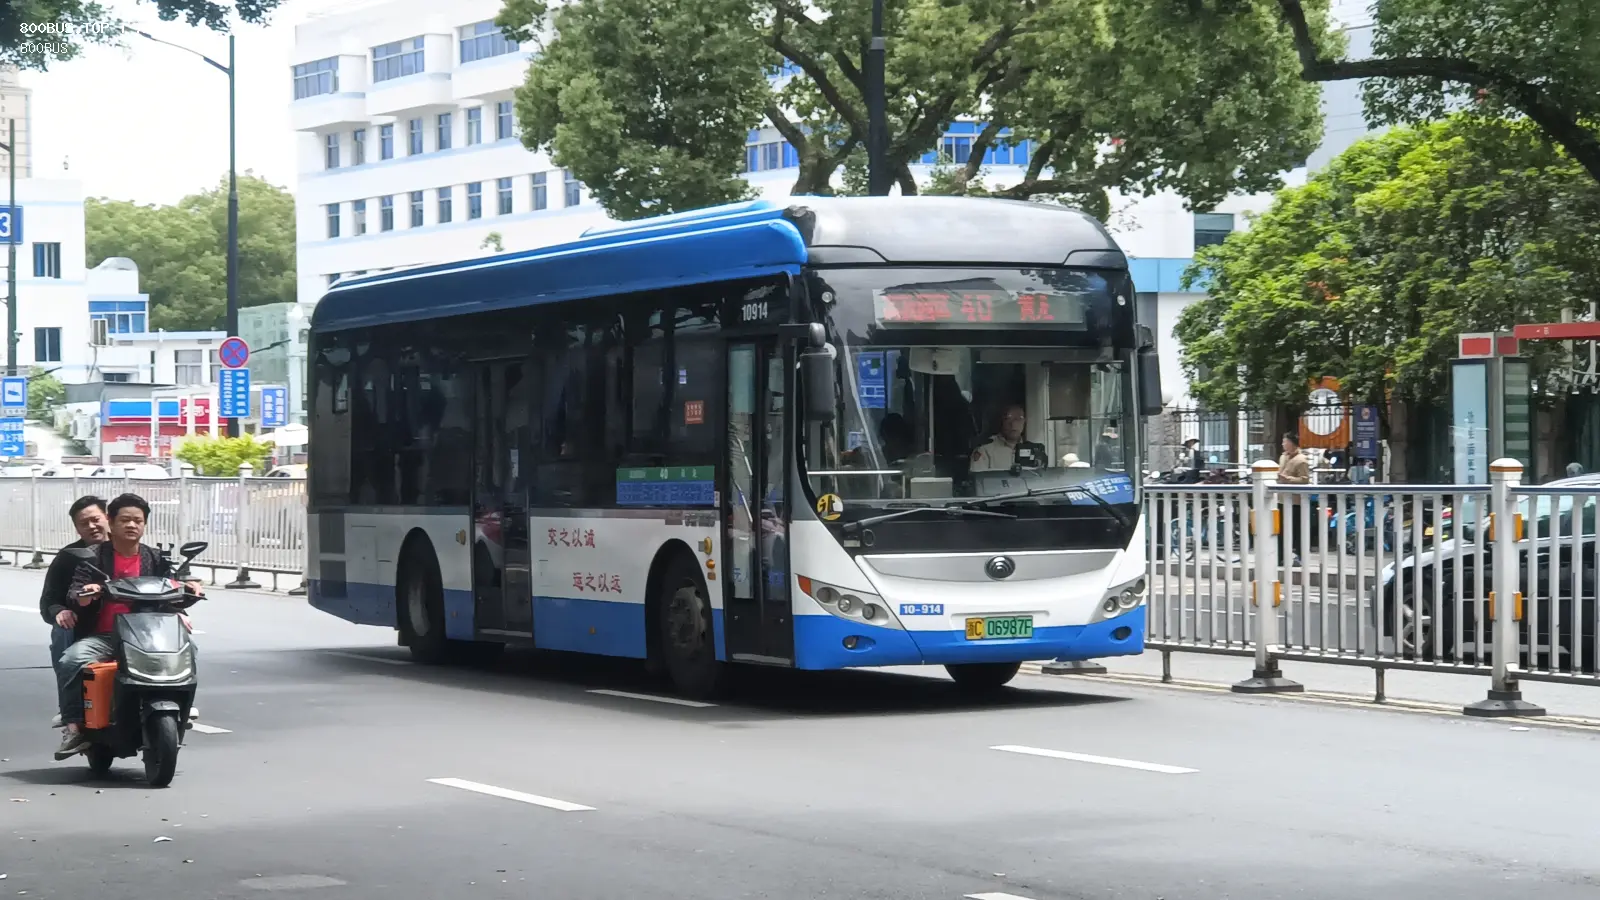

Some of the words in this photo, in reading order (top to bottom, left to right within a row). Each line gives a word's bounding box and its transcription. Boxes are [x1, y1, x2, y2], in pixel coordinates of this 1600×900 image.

[741, 301, 768, 321] 10914
[547, 527, 596, 549] 交之以诚
[572, 572, 622, 594] 运之以远
[902, 604, 941, 615] 10-914
